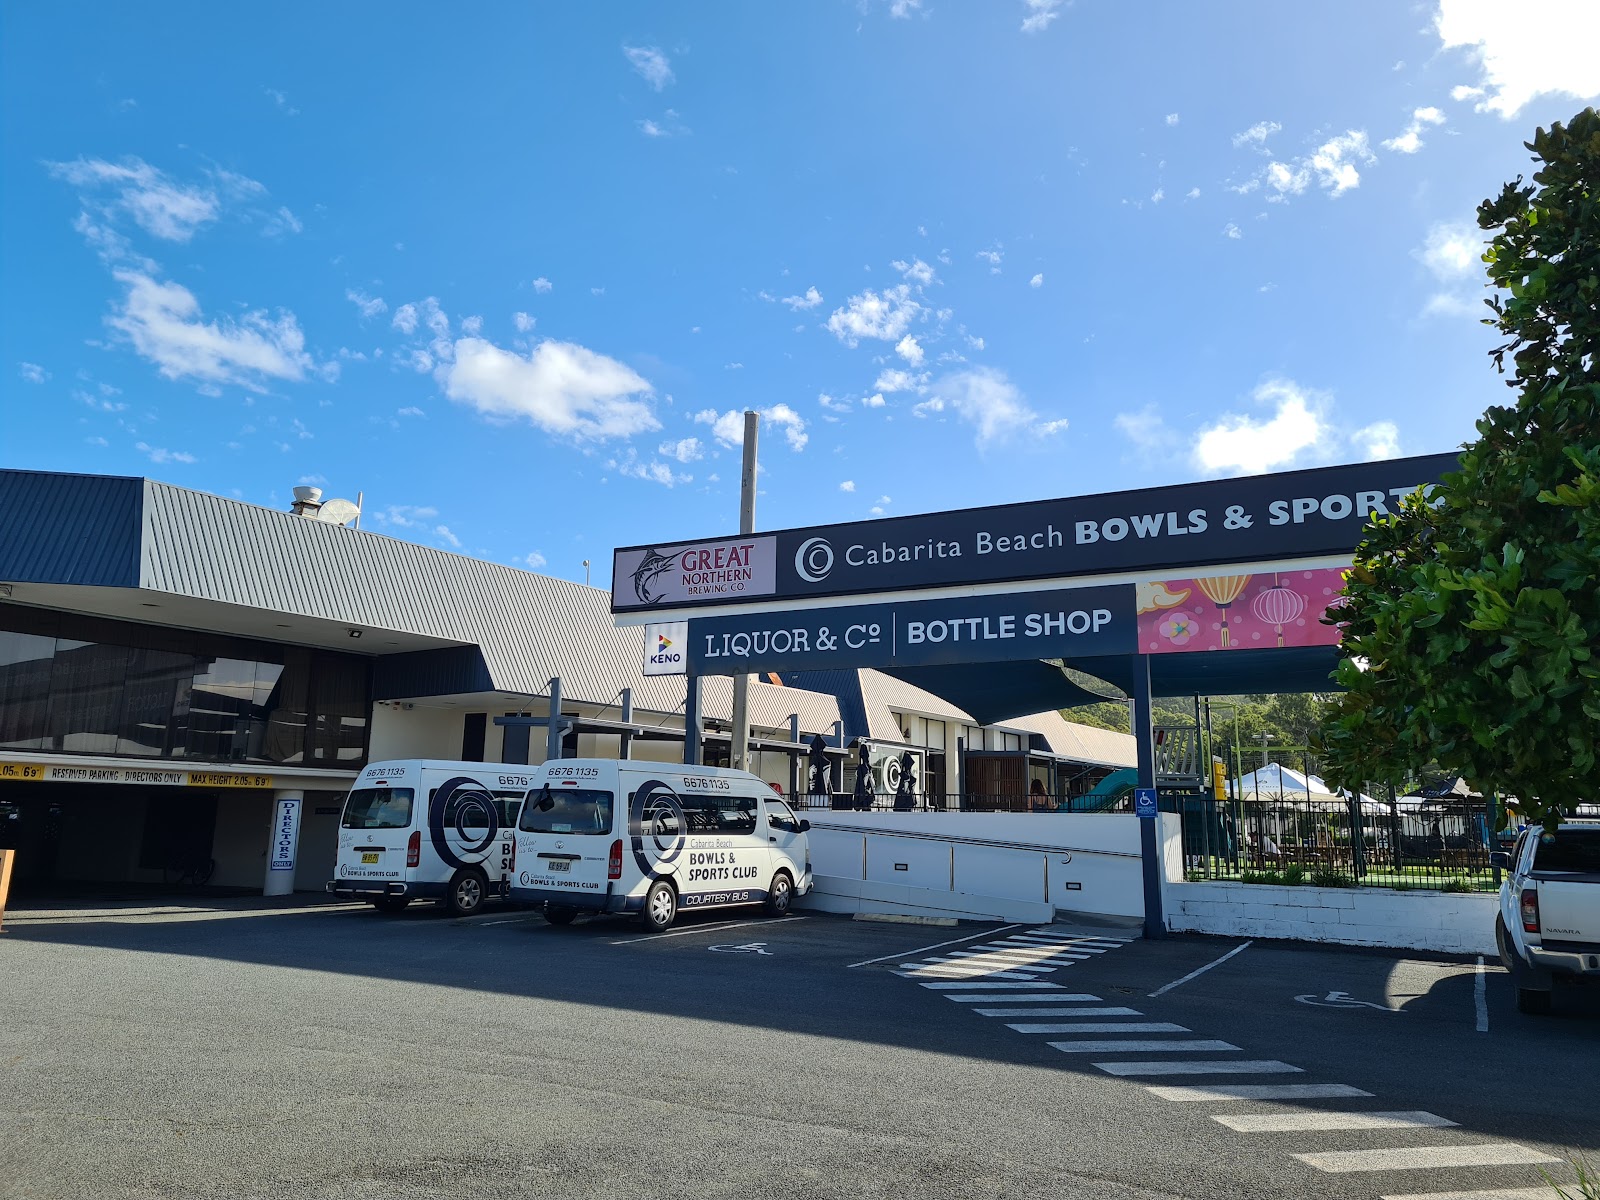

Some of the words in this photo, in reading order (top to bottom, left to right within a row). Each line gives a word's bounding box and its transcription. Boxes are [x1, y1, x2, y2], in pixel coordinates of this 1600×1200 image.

[845, 535, 962, 566] Cabarita
[976, 525, 1063, 554] Beach
[1075, 509, 1208, 545] BOWLS
[1223, 505, 1254, 530] &
[681, 544, 755, 571] GREAT
[682, 568, 752, 586] NORTHERN
[688, 584, 727, 595] BREWING
[730, 582, 746, 591] CO.
[908, 615, 1016, 644] BOTTLE
[1024, 609, 1112, 637] SHOP
[705, 628, 810, 657] LIQUOR
[816, 626, 838, 650] &
[650, 653, 681, 663] KENO
[52, 768, 87, 780] RESERVED
[89, 769, 119, 781] PARKING
[125, 771, 163, 782] DIRECTORS
[163, 773, 182, 783] ONLY
[367, 769, 386, 777] 6676
[387, 768, 406, 776] 1135
[548, 767, 574, 776] 6676
[575, 767, 599, 776] 1135
[209, 774, 233, 785] HEIGHT
[498, 776, 528, 786] 6676
[683, 777, 708, 788] 6676
[709, 779, 730, 789] 1135
[279, 802, 295, 859] DIRECTORS
[690, 838, 714, 848] Cabarita
[716, 838, 733, 848] Beach
[689, 852, 725, 865] BOWLS
[729, 852, 736, 864] &
[688, 867, 729, 881] SPORTS
[732, 866, 758, 878] CLUB
[686, 893, 731, 905] COURTESY
[732, 891, 749, 901] BUS
[1546, 927, 1581, 935] NAVARA
